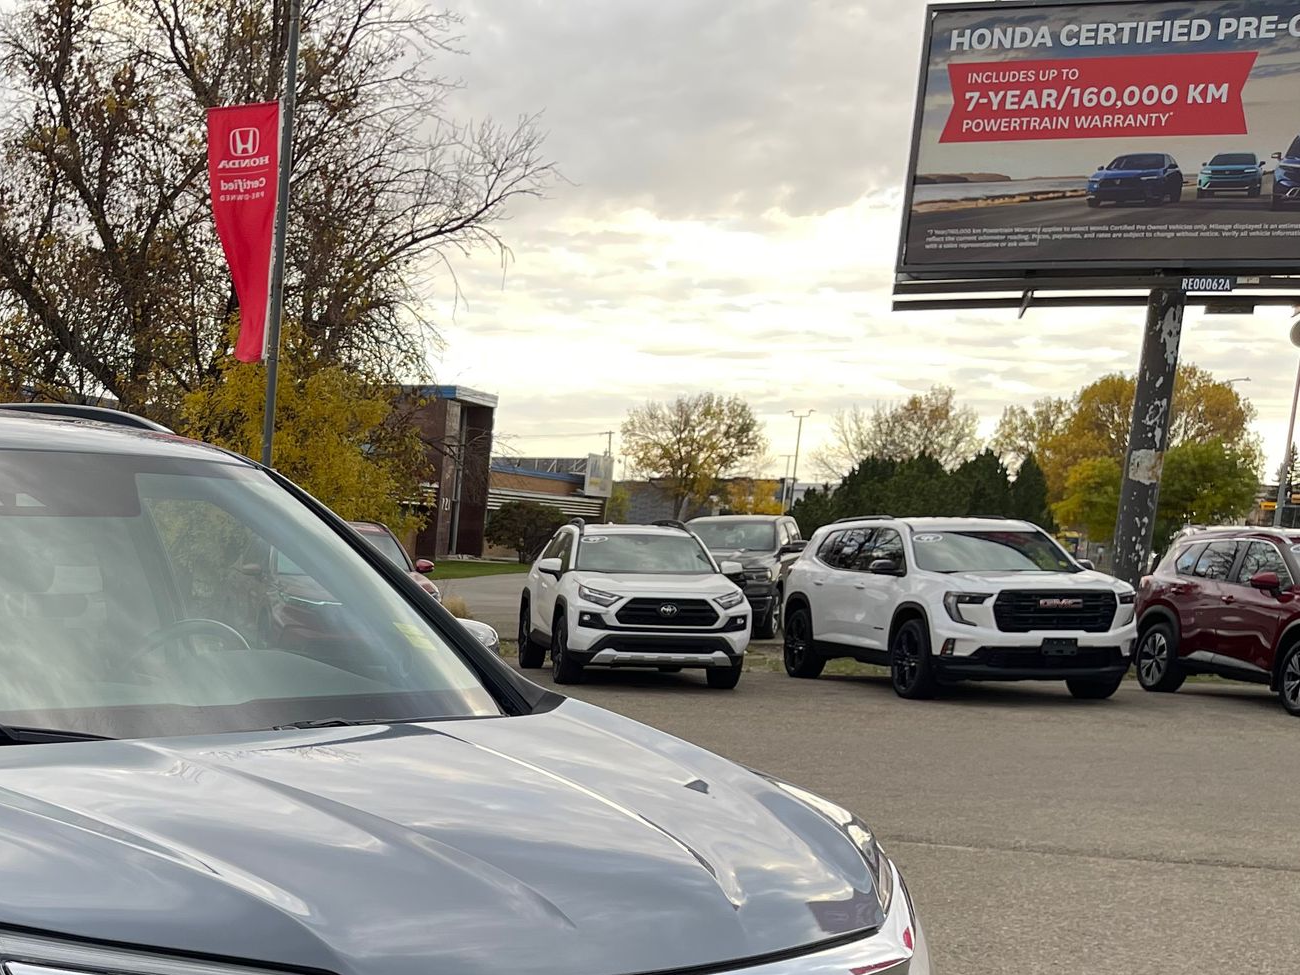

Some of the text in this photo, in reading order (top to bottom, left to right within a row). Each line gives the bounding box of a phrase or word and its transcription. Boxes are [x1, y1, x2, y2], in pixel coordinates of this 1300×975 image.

[950, 25, 1053, 51] HONDA
[1060, 18, 1211, 47] CERTIFIED
[967, 68, 1079, 84] INCLUDES UP TO
[965, 83, 1229, 111] 7-YEAR/160,000 KM
[962, 116, 1069, 133] POWERTRAIN
[1123, 231, 1144, 239] subject
[1222, 230, 1239, 238] Verify
[1209, 223, 1232, 231] Mileage
[1233, 223, 1262, 231] displayed
[1181, 278, 1230, 290] RE00062A
